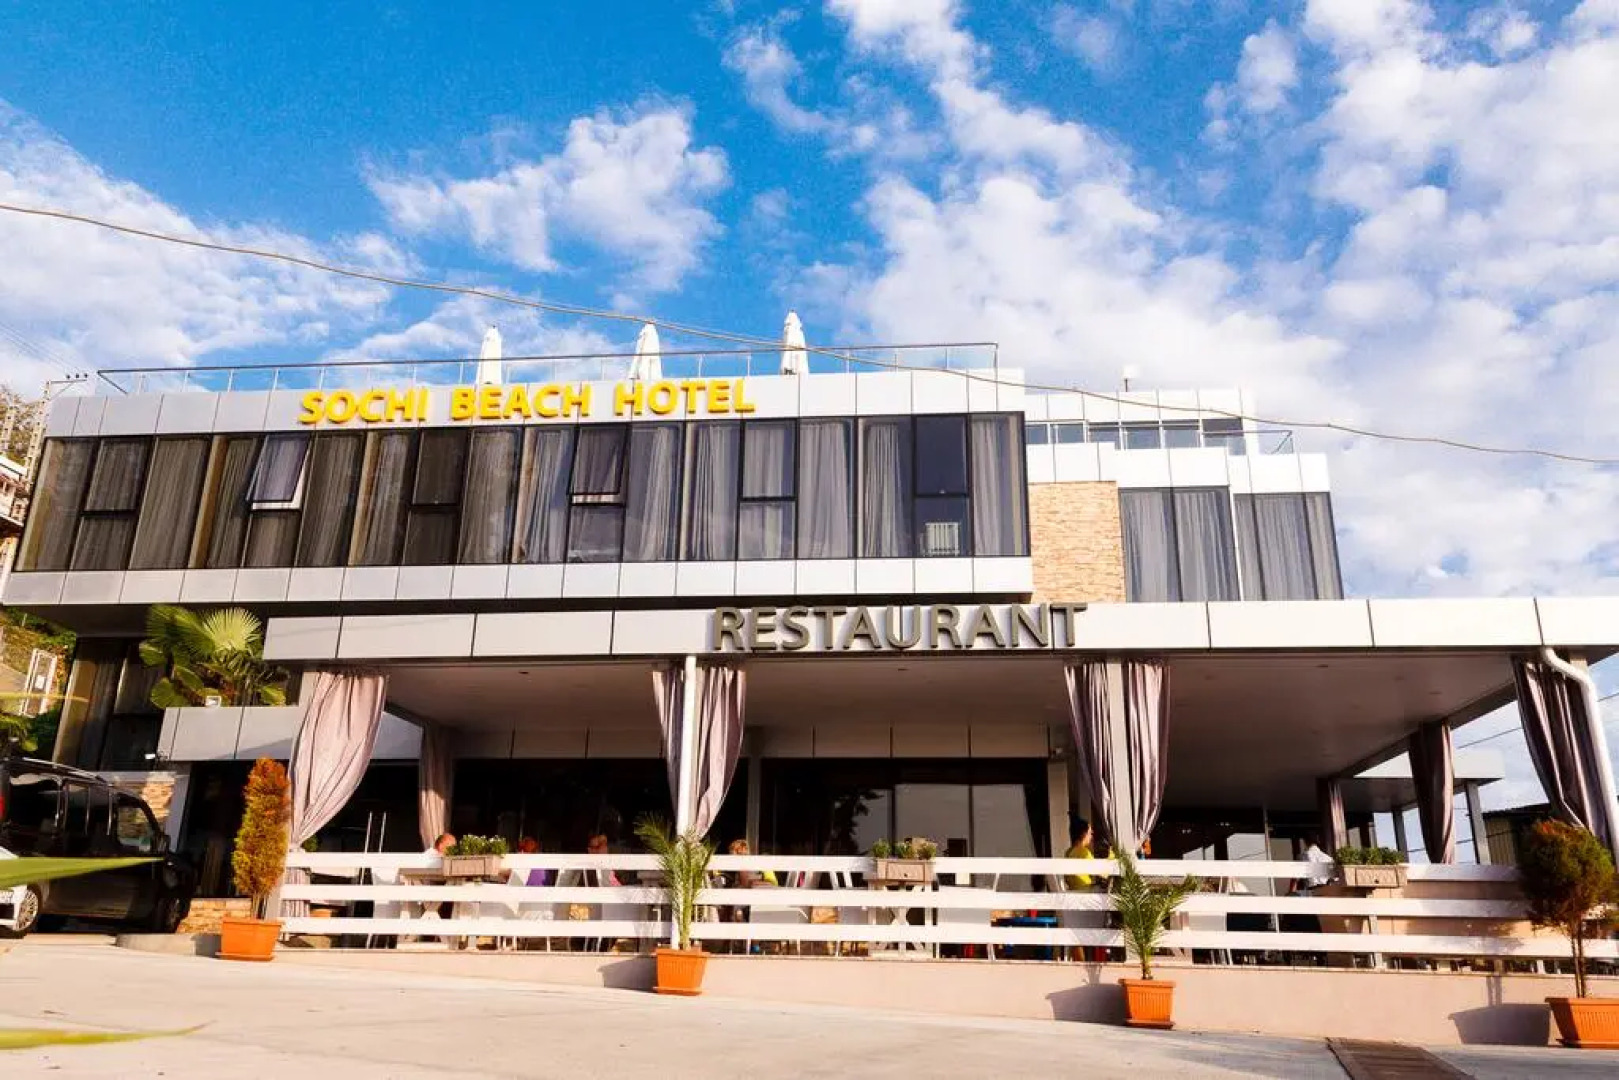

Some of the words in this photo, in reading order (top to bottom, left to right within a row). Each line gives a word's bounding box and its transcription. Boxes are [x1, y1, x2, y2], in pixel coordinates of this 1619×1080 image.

[299, 387, 429, 424] SOCHI
[450, 381, 591, 421] BEACH
[614, 377, 756, 415] HOTEL
[713, 602, 1088, 652] RESTAURANT
